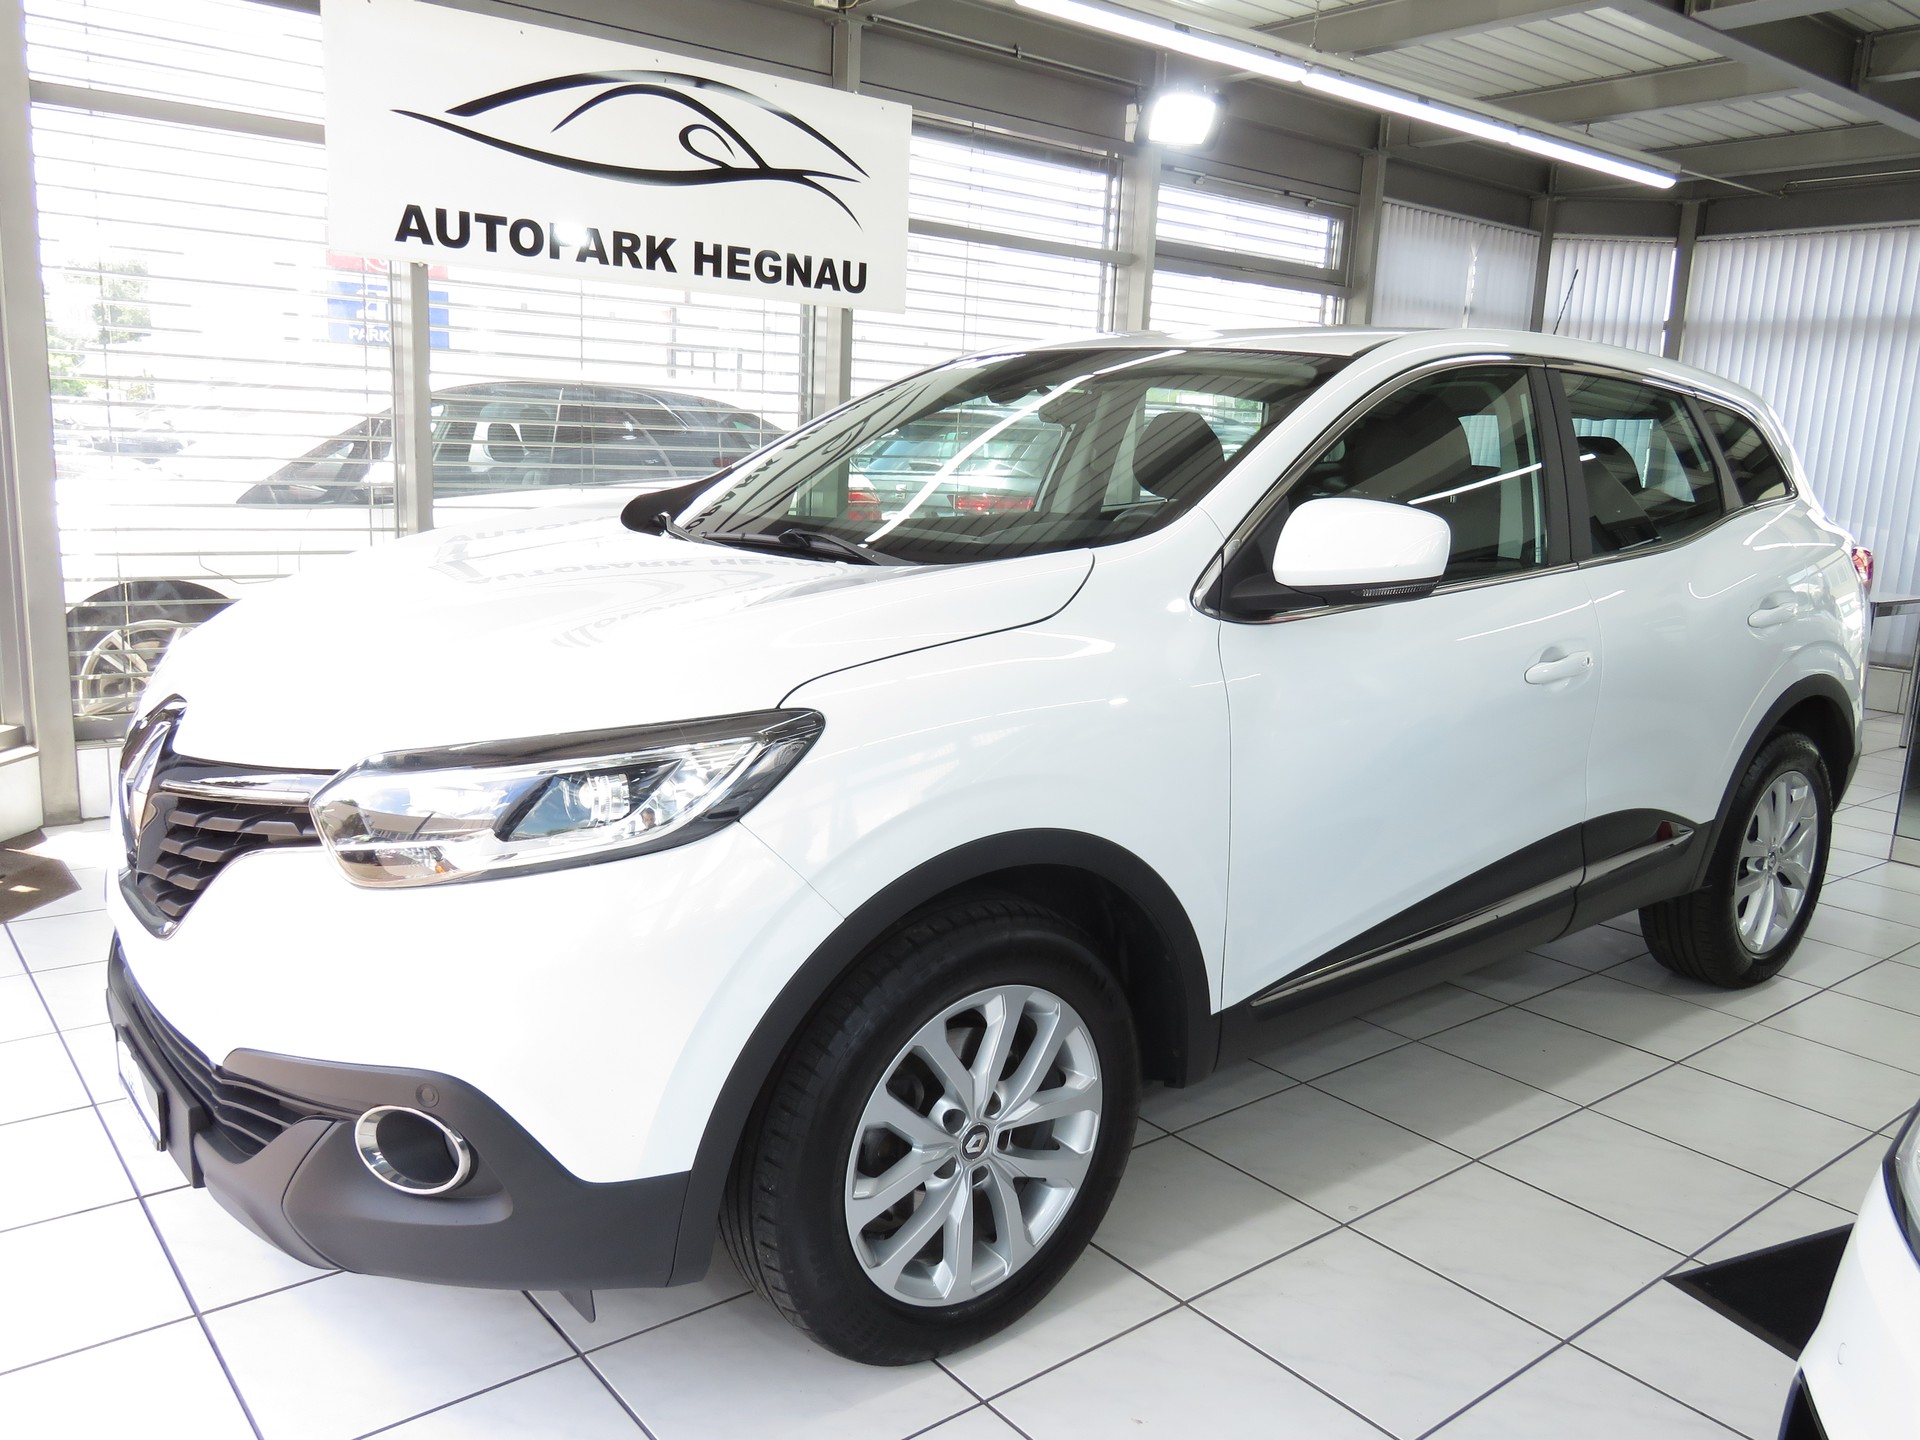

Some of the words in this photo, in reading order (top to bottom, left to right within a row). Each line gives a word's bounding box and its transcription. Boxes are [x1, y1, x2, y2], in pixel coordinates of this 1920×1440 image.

[394, 204, 678, 273] AUTOPARK
[694, 241, 867, 294] HEGNAU
[348, 325, 391, 344] PARK
